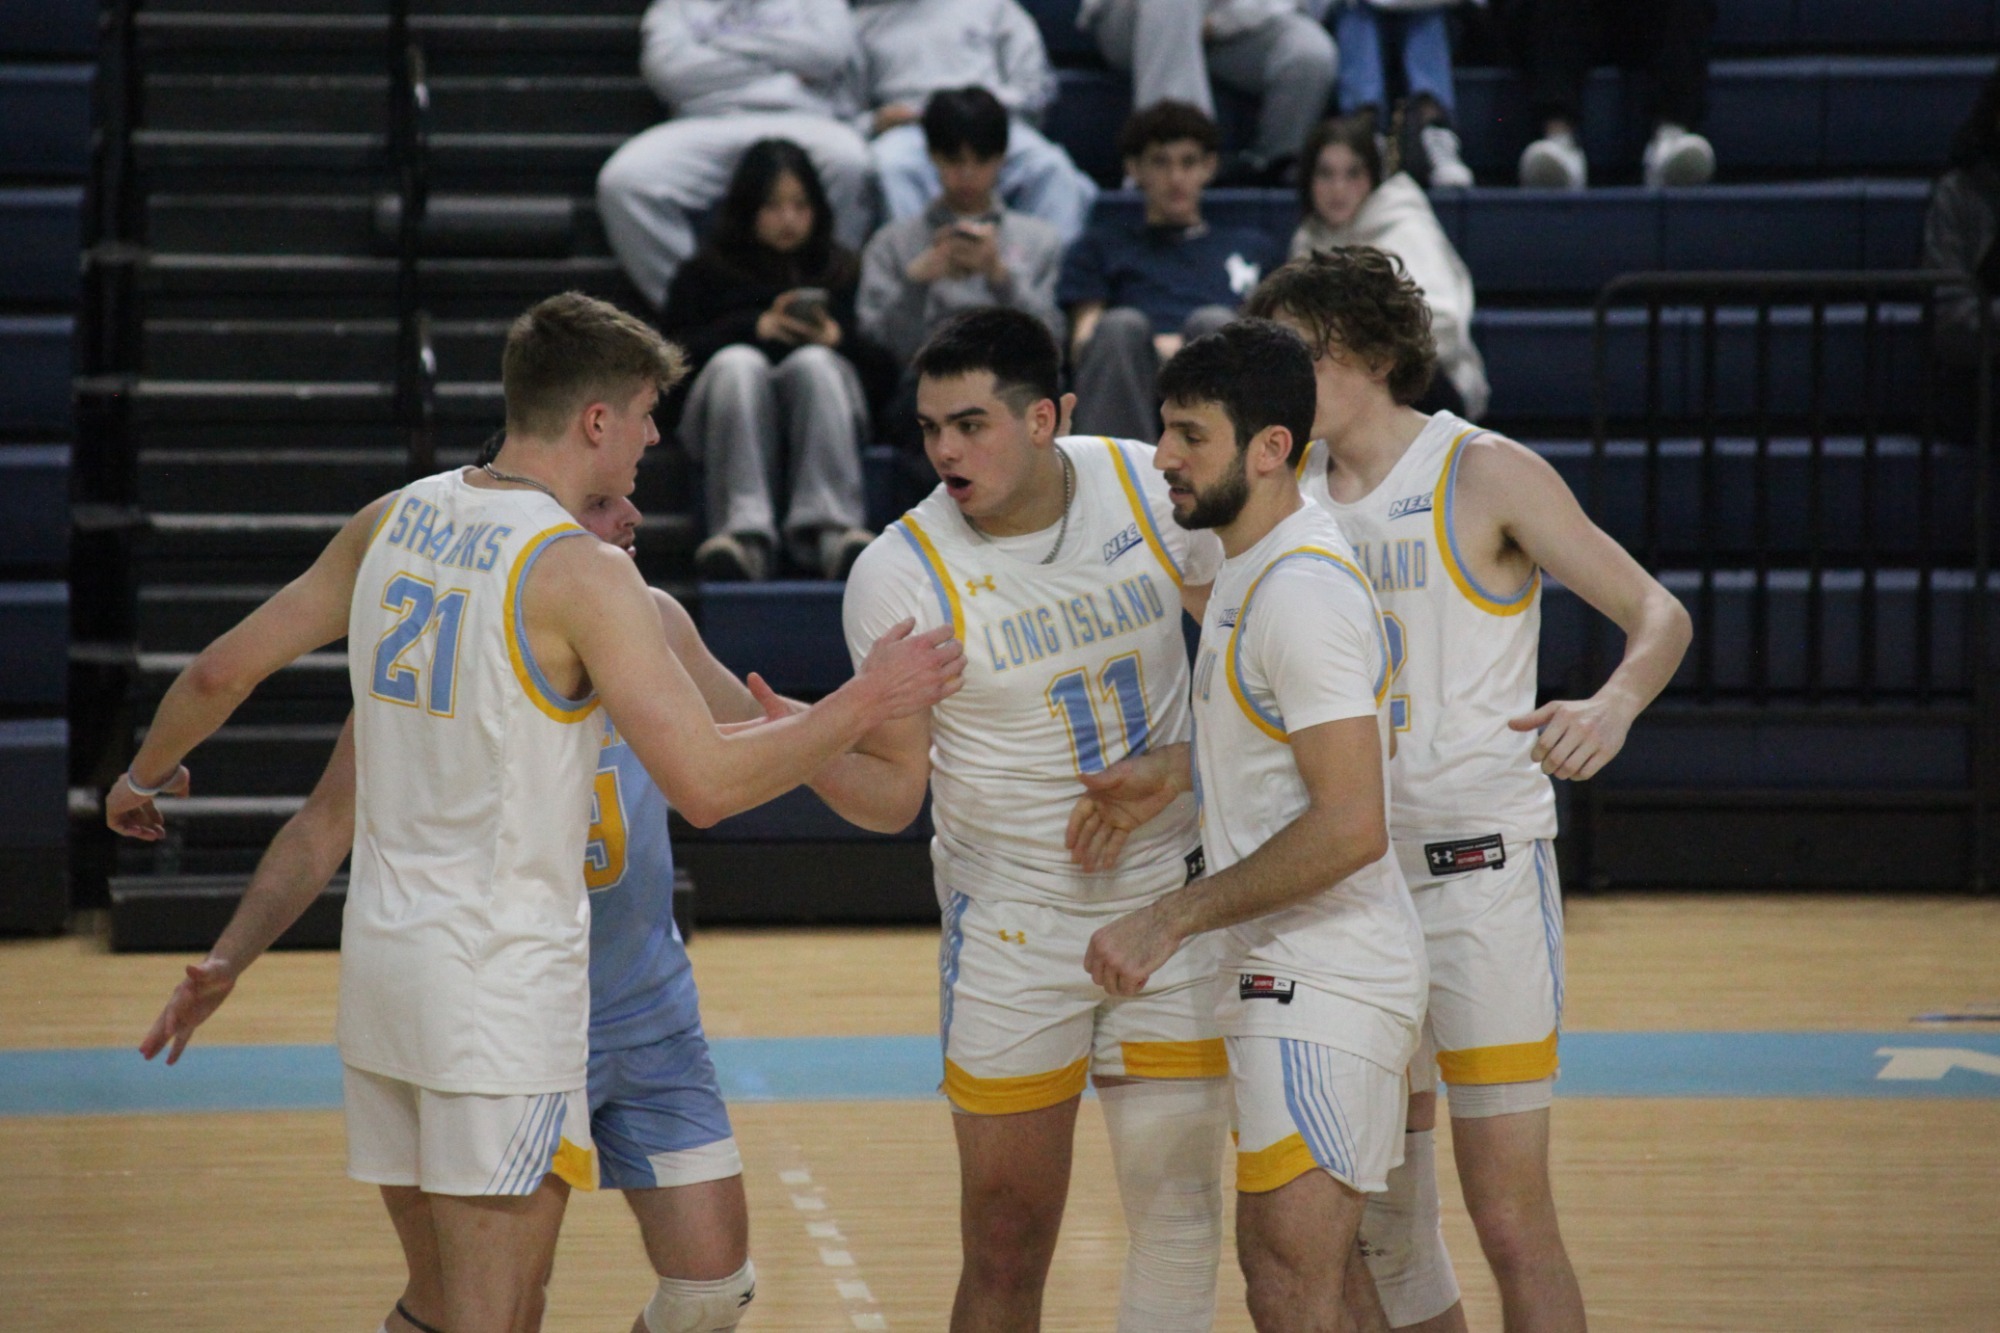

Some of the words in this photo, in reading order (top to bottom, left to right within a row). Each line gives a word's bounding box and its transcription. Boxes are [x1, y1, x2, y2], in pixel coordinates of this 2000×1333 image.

[388, 497, 512, 573] SHARKS
[369, 571, 471, 719] 21
[982, 605, 1062, 674] LONG
[1056, 571, 1166, 649] ISLAND
[1044, 649, 1153, 776] 11
